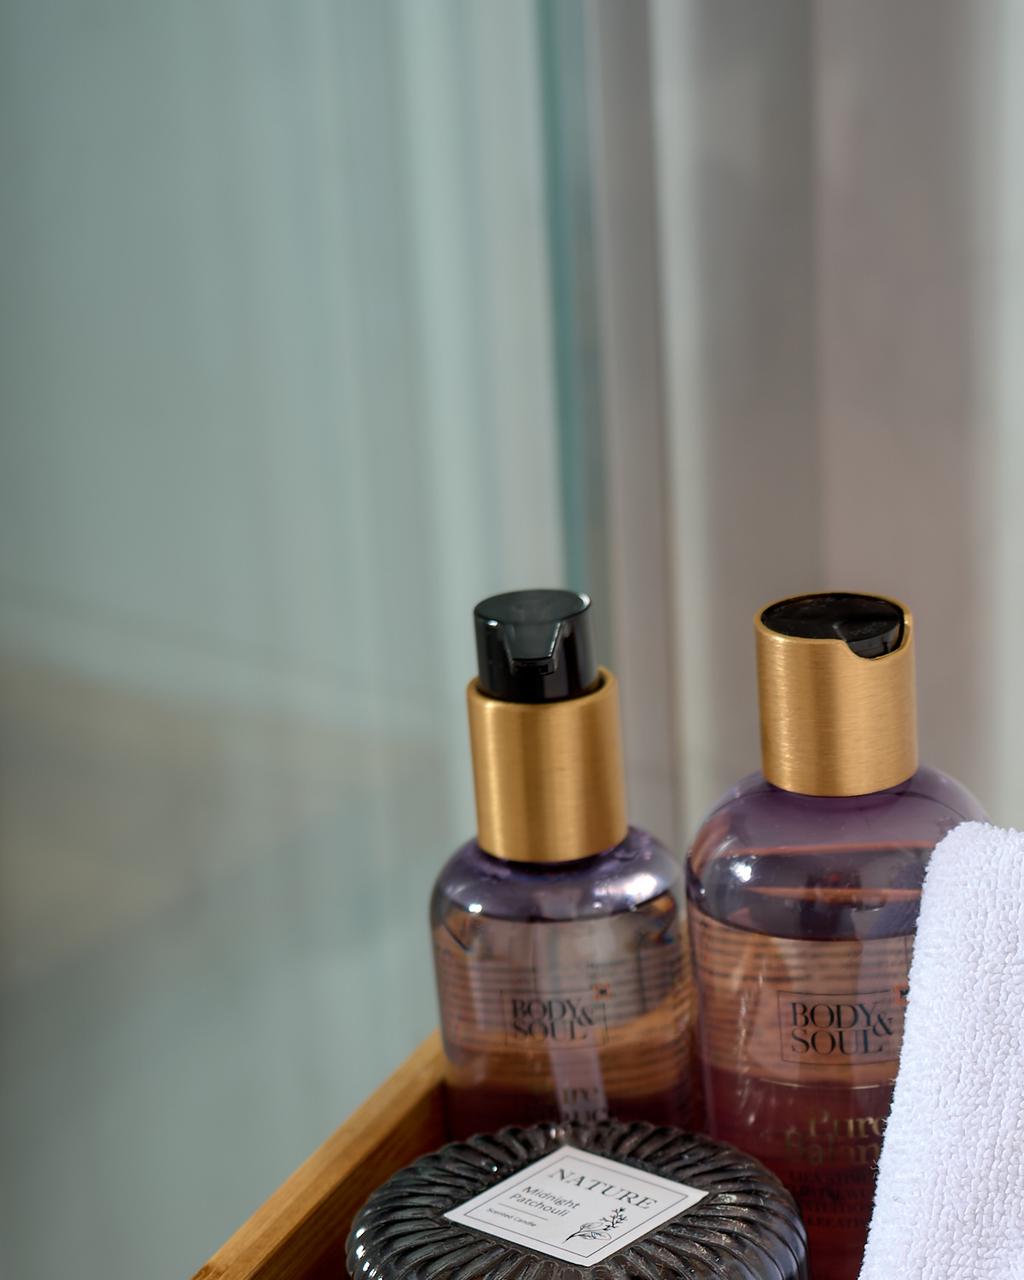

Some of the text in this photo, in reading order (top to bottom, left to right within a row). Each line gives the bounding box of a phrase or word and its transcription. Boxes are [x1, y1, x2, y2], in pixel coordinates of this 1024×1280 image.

[512, 1019, 588, 1041] SOUL
[791, 1028, 883, 1055] SOUL
[522, 1186, 580, 1208] Midnight
[549, 1168, 658, 1210] NATURE
[509, 1193, 572, 1217] Patchouli
